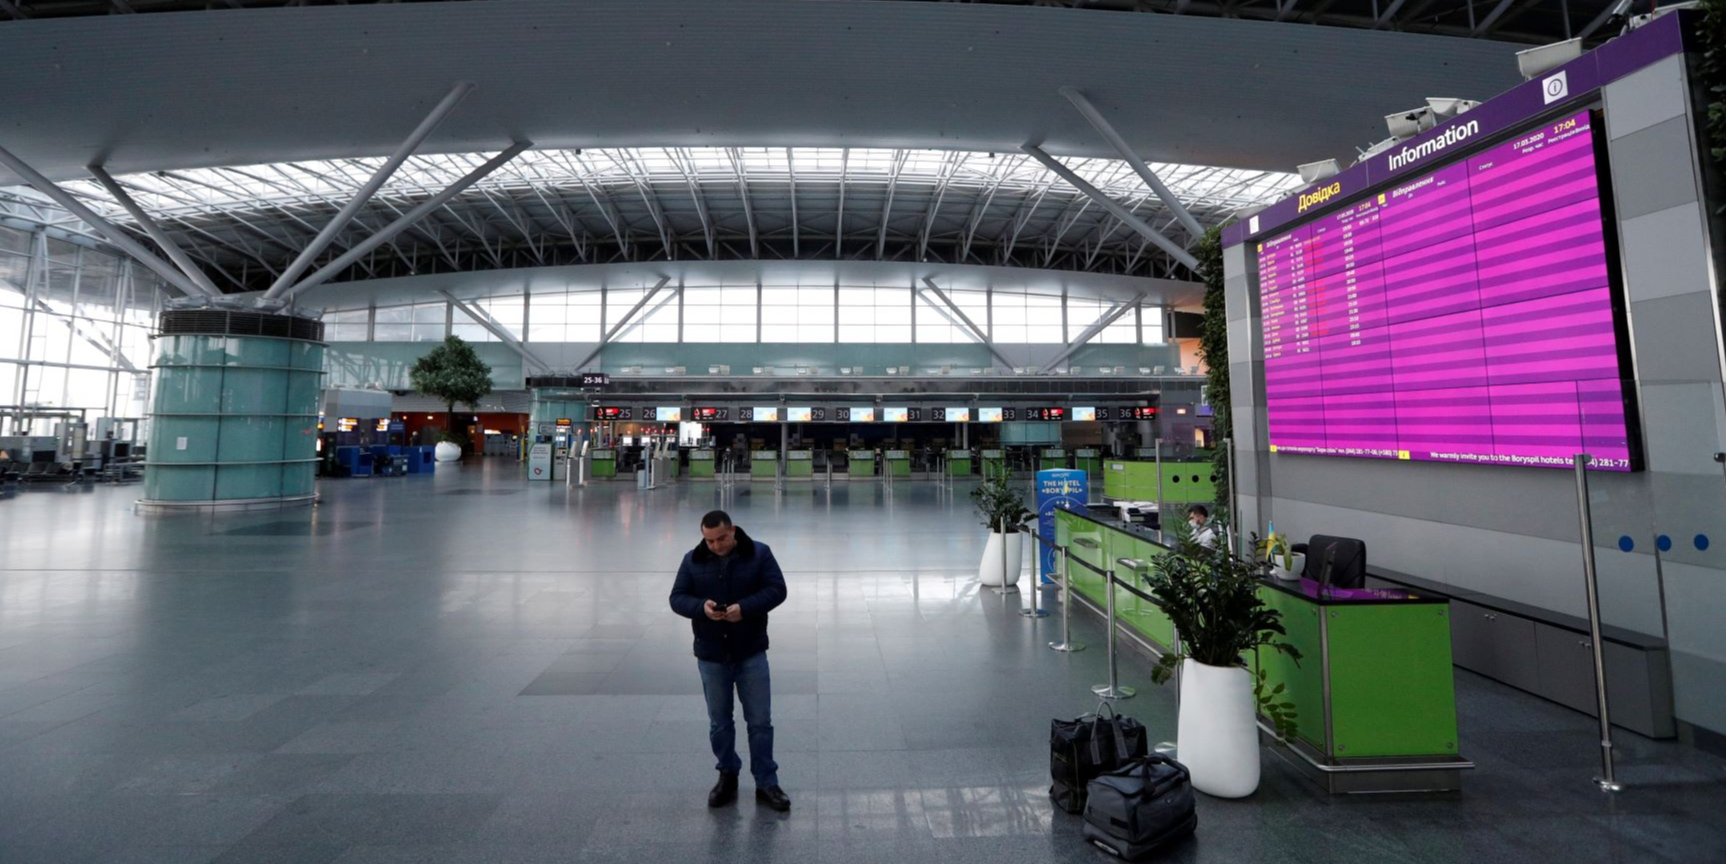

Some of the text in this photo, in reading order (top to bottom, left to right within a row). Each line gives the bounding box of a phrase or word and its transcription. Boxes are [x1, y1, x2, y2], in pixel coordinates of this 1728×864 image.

[1553, 118, 1576, 134] 17:04
[1388, 118, 1479, 171] Information
[1297, 180, 1341, 213] Довідка
[583, 376, 603, 384] 25-36
[619, 408, 631, 418] 25
[643, 409, 656, 419] 26
[716, 409, 728, 418] 27
[740, 409, 753, 418] 28
[812, 409, 825, 419] 29
[837, 409, 849, 419] 30
[909, 409, 920, 419] 31
[933, 409, 945, 419] 32
[1004, 409, 1015, 419] 33
[1027, 409, 1039, 419] 34
[1097, 409, 1108, 418] 35
[1120, 409, 1132, 418] 36
[1439, 452, 1459, 461] warmly
[1478, 454, 1490, 462] you
[1499, 454, 1511, 462] the
[1511, 455, 1540, 464] Boryspil
[1540, 456, 1564, 465] hotels
